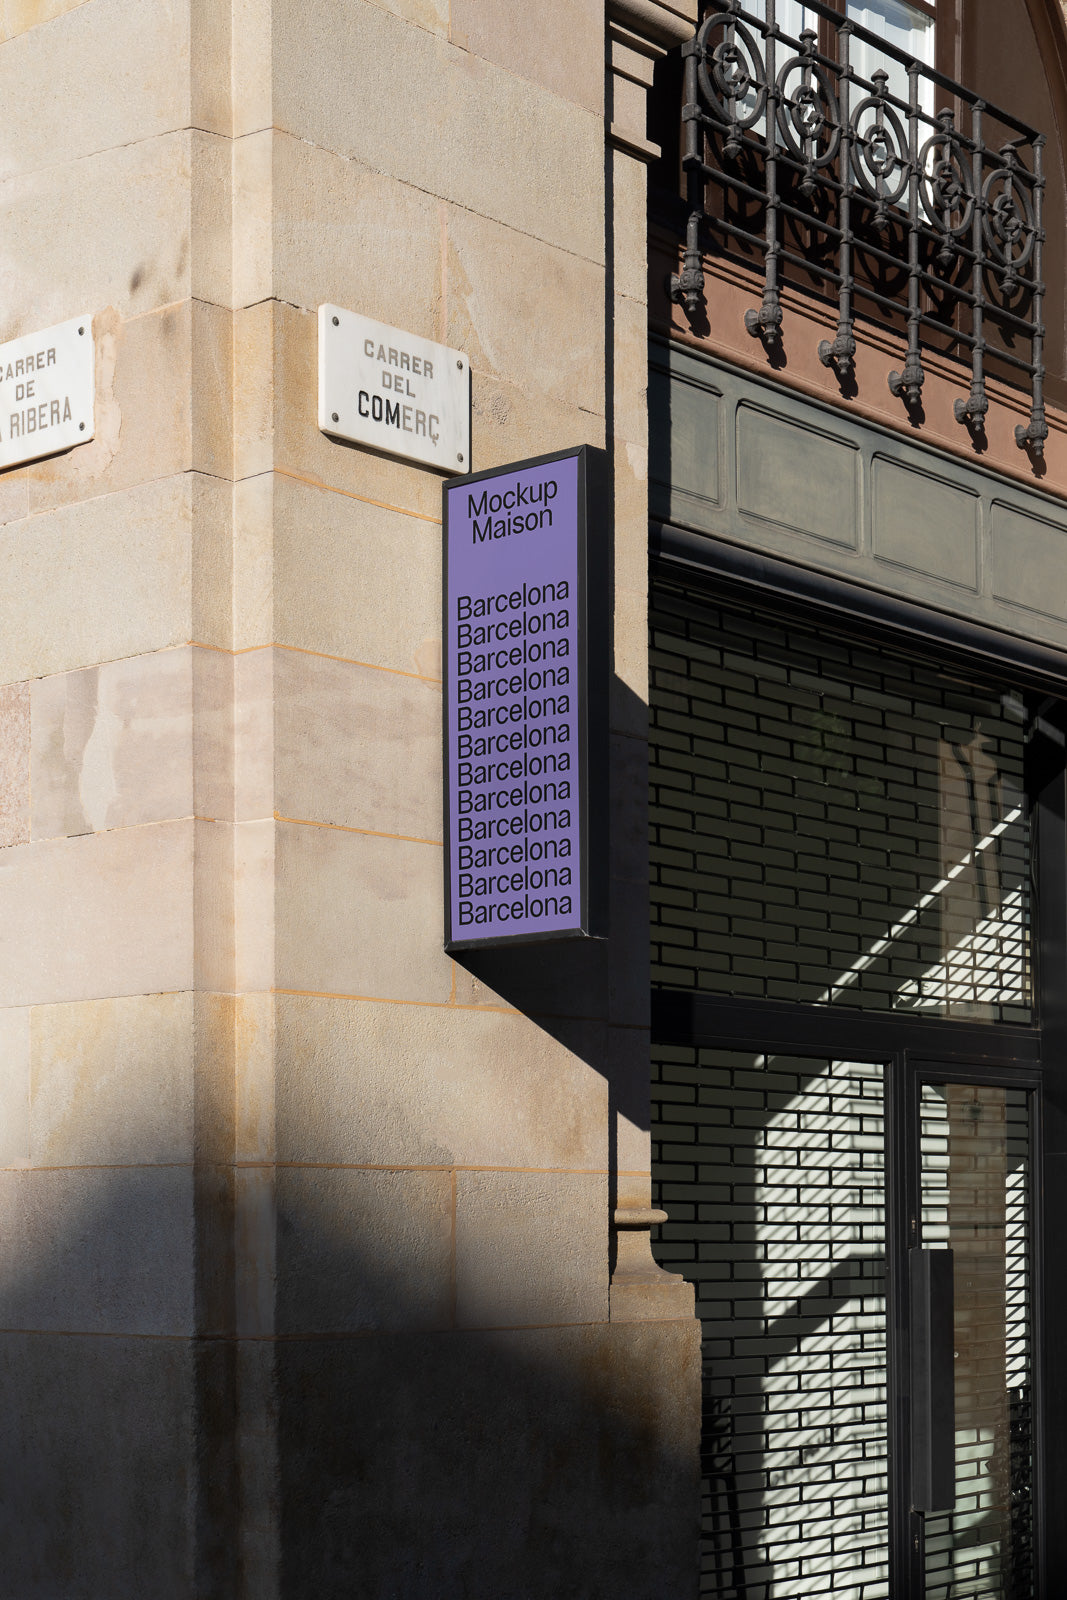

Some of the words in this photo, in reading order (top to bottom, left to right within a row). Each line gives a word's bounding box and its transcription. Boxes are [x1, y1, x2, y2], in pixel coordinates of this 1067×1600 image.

[364, 338, 434, 379] CARRER
[15, 379, 36, 401] DE
[382, 370, 416, 398] DEL
[10, 396, 72, 439] RIBERA
[358, 390, 440, 447] COMERÇ
[468, 479, 558, 519] Mockup
[472, 508, 553, 544] Maison
[457, 580, 569, 621] Barcelona
[457, 609, 569, 649] Barcelona
[457, 637, 569, 677] Barcelona
[457, 666, 570, 704] Barcelona
[457, 694, 570, 732] Barcelona
[457, 723, 570, 760] Barcelona
[458, 752, 571, 787] Barcelona
[458, 780, 571, 815] Barcelona
[458, 809, 571, 843] Barcelona
[458, 838, 571, 871] Barcelona
[458, 866, 572, 899] Barcelona
[458, 893, 572, 926] Barcelona
